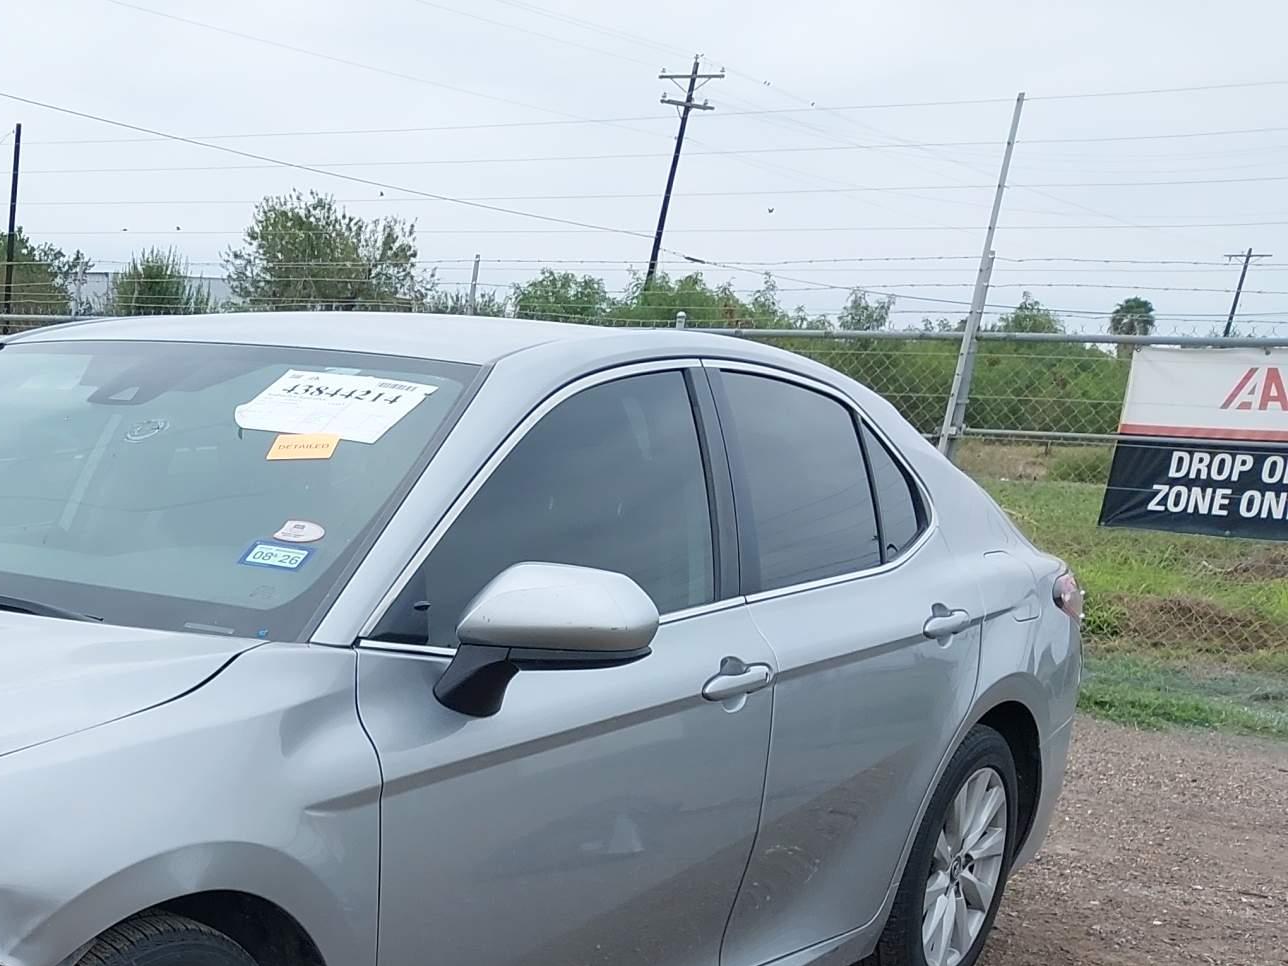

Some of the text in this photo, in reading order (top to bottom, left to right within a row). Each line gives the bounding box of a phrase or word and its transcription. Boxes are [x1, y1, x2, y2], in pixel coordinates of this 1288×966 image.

[282, 384, 403, 404] 43844214
[1168, 451, 1288, 484] DROP O
[1147, 484, 1288, 520] ZONE ON
